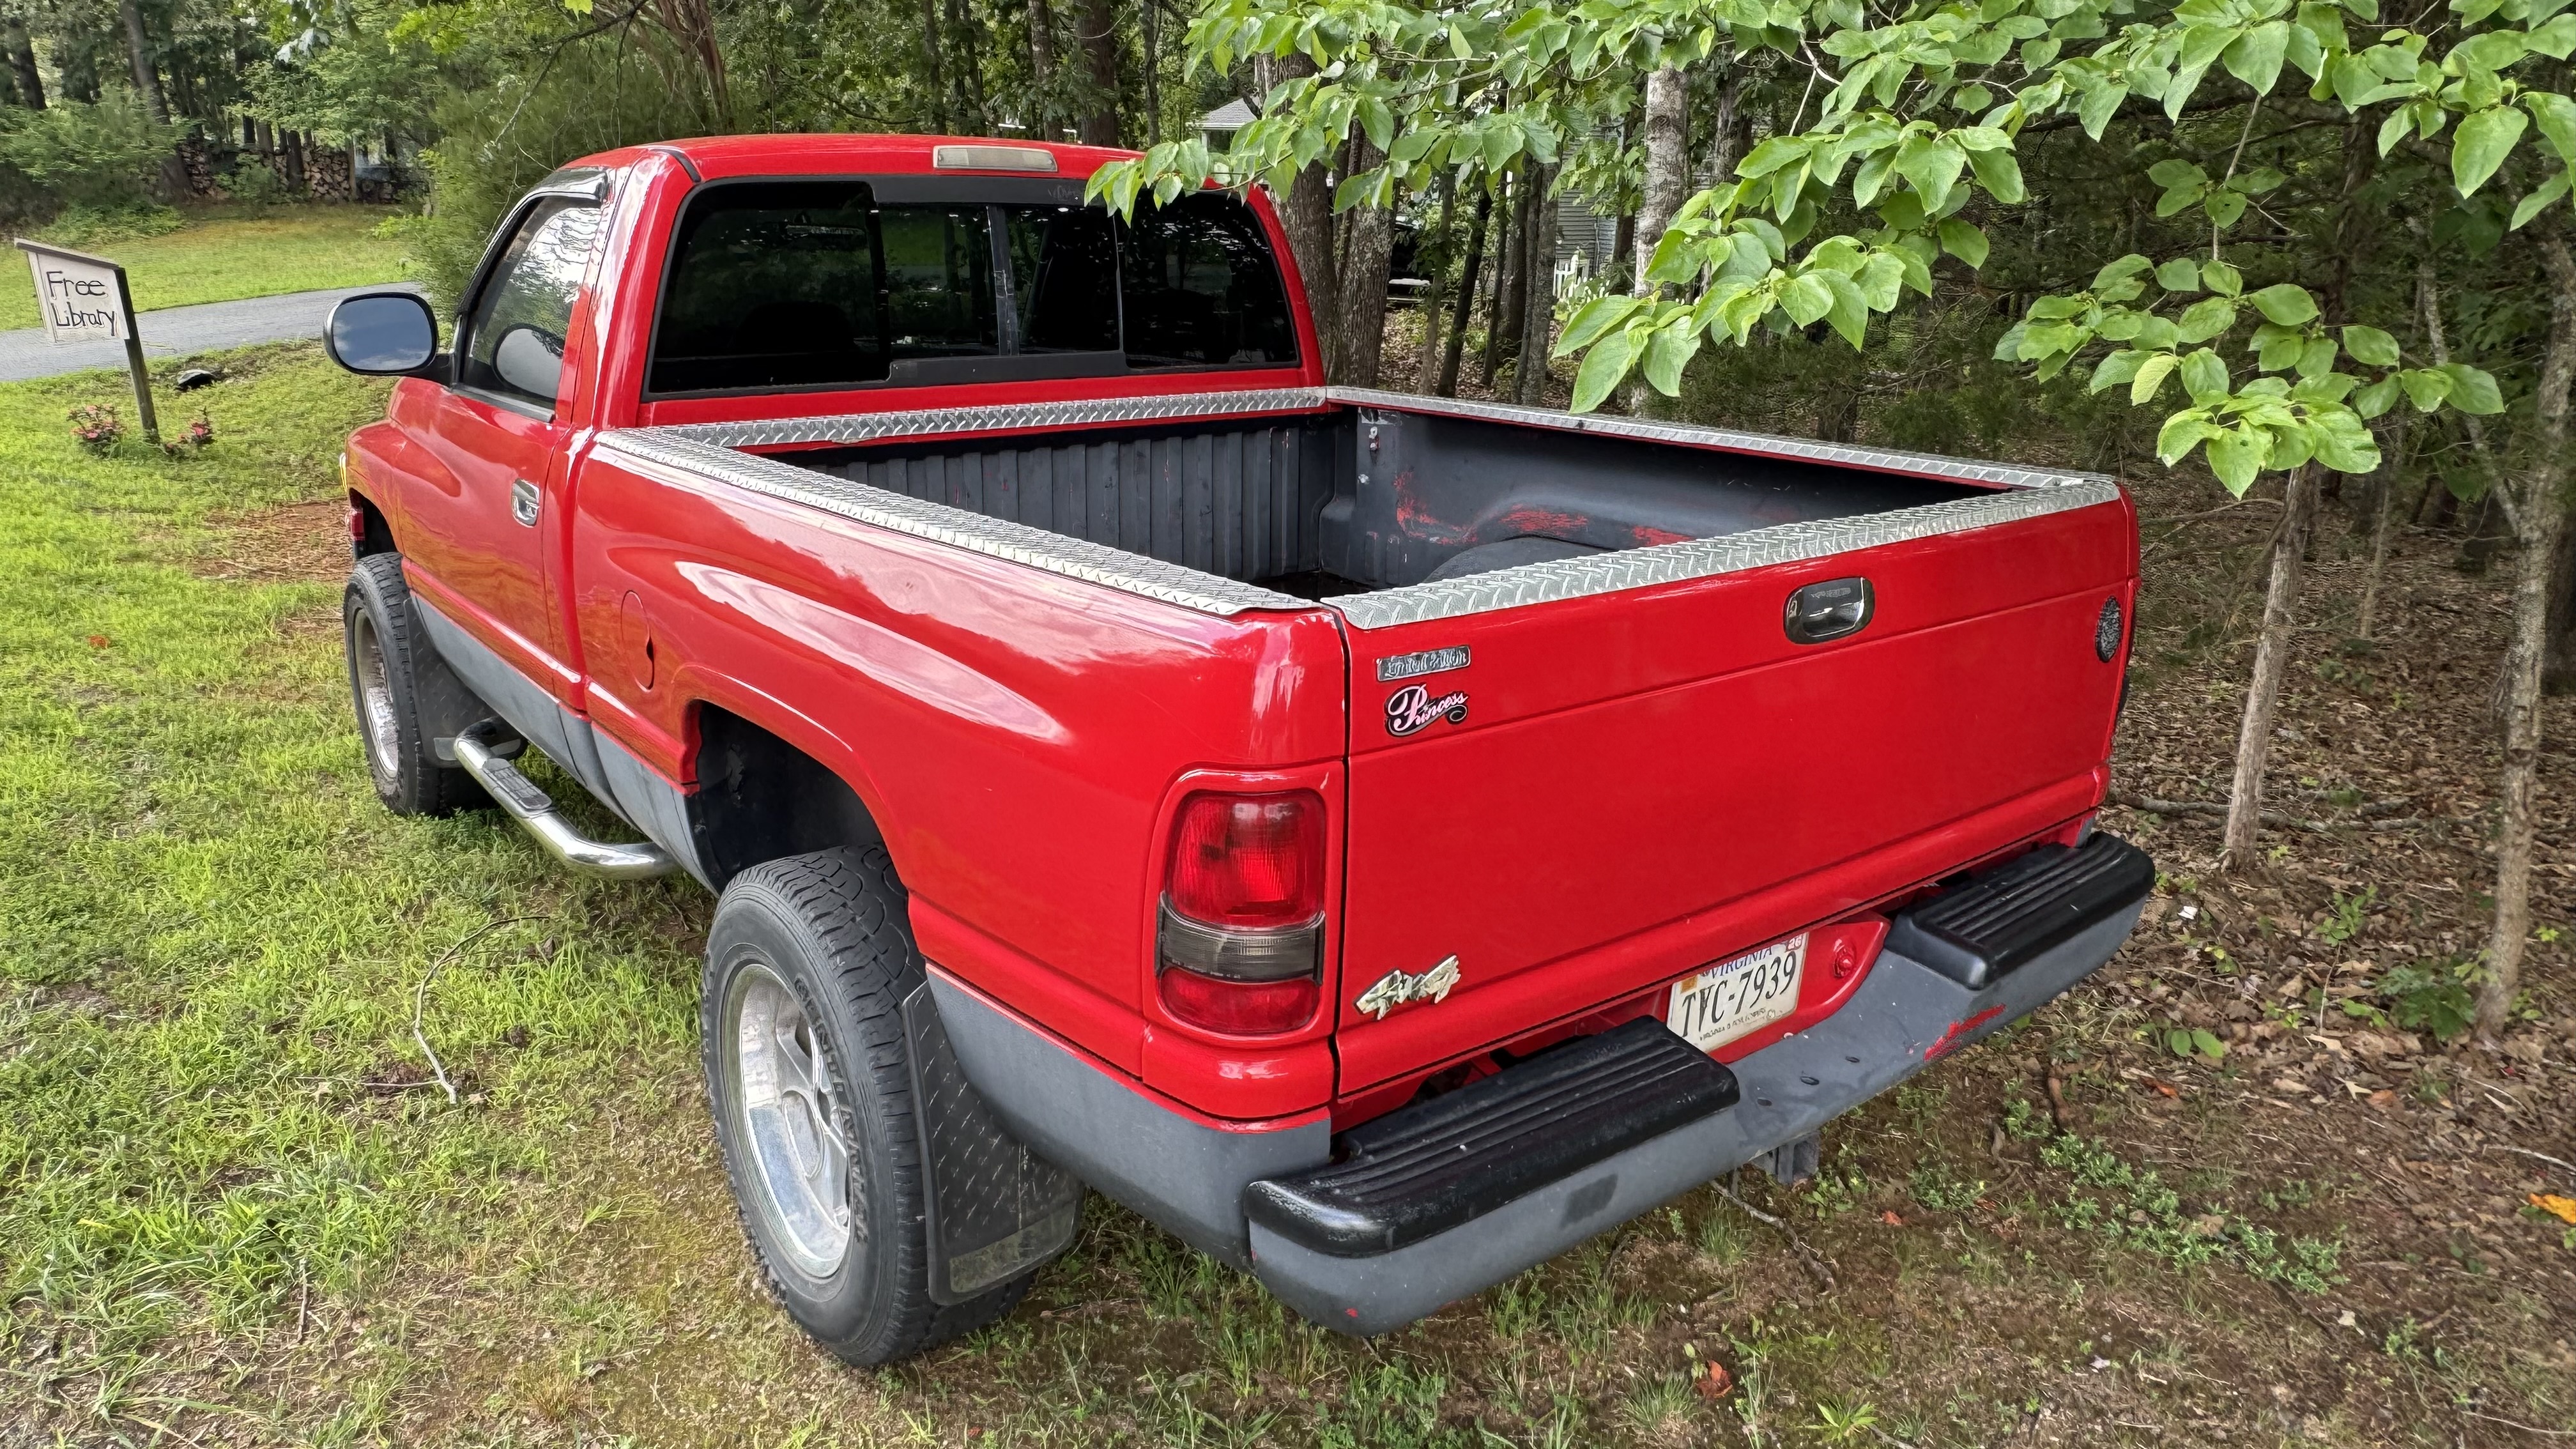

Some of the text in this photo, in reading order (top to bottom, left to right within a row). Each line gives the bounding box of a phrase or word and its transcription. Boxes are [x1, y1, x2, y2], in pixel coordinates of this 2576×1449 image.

[46, 270, 105, 297] Free
[50, 301, 115, 336] Library
[1388, 684, 1469, 732] Princess
[1708, 947, 1772, 979] VIRGINIA
[1682, 950, 1797, 1038] TVC-7939
